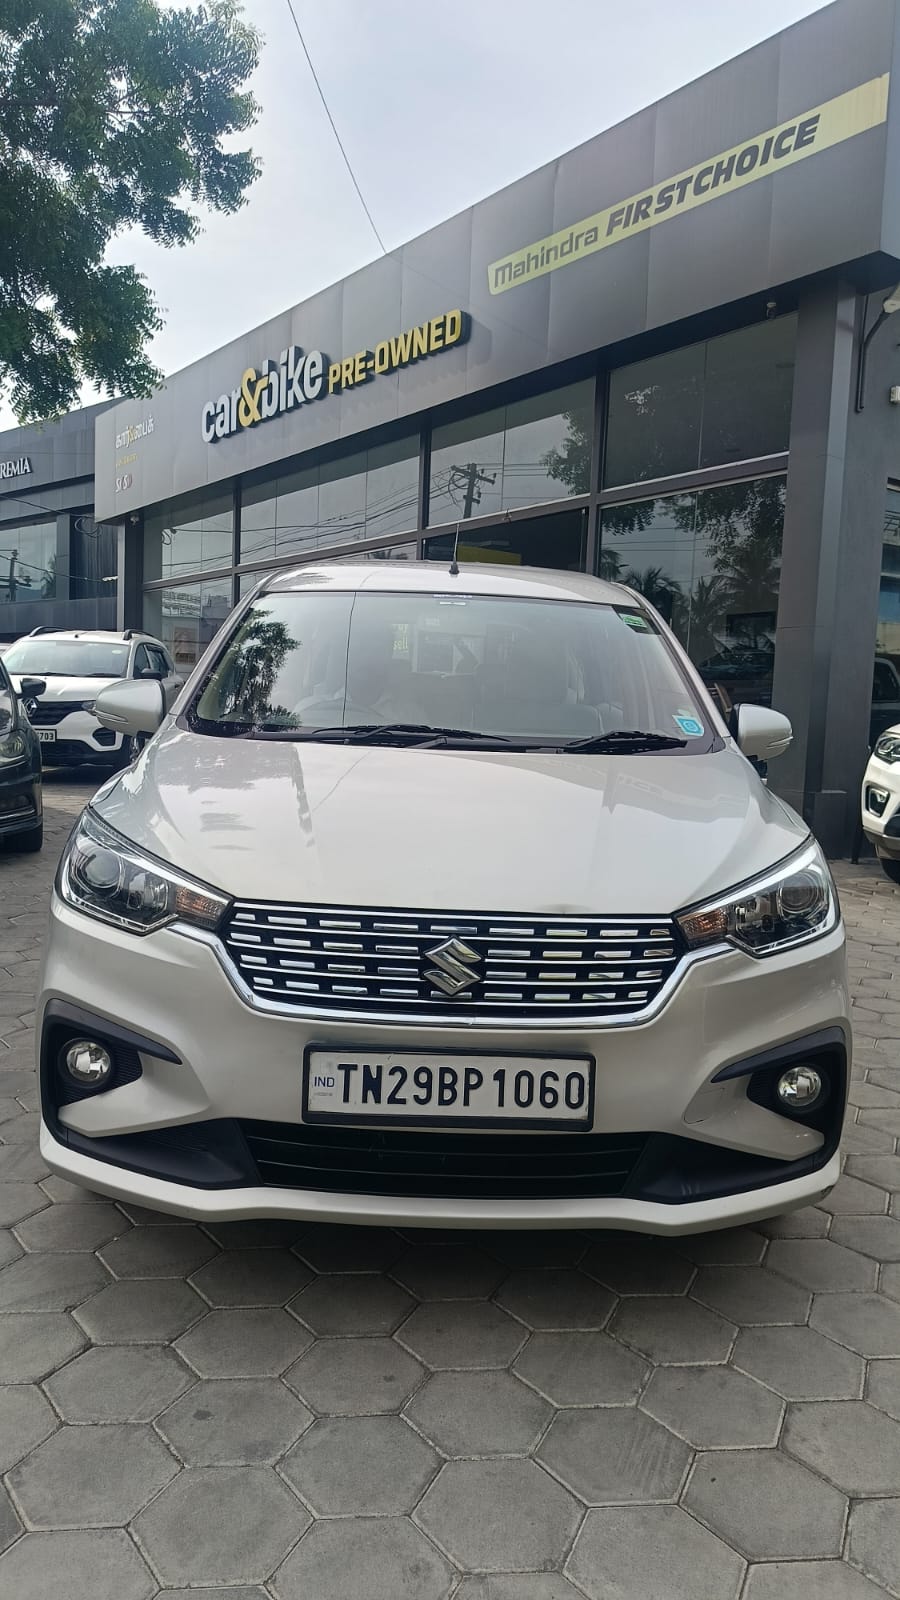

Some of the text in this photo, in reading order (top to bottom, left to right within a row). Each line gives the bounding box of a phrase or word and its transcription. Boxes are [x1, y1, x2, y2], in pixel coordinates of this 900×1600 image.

[494, 113, 821, 289] Mahindra FIRSTCHOICE
[201, 309, 467, 443] car&bike PRE-OWNED
[314, 1076, 335, 1088] IND
[337, 1063, 585, 1109] TN29BP1060
